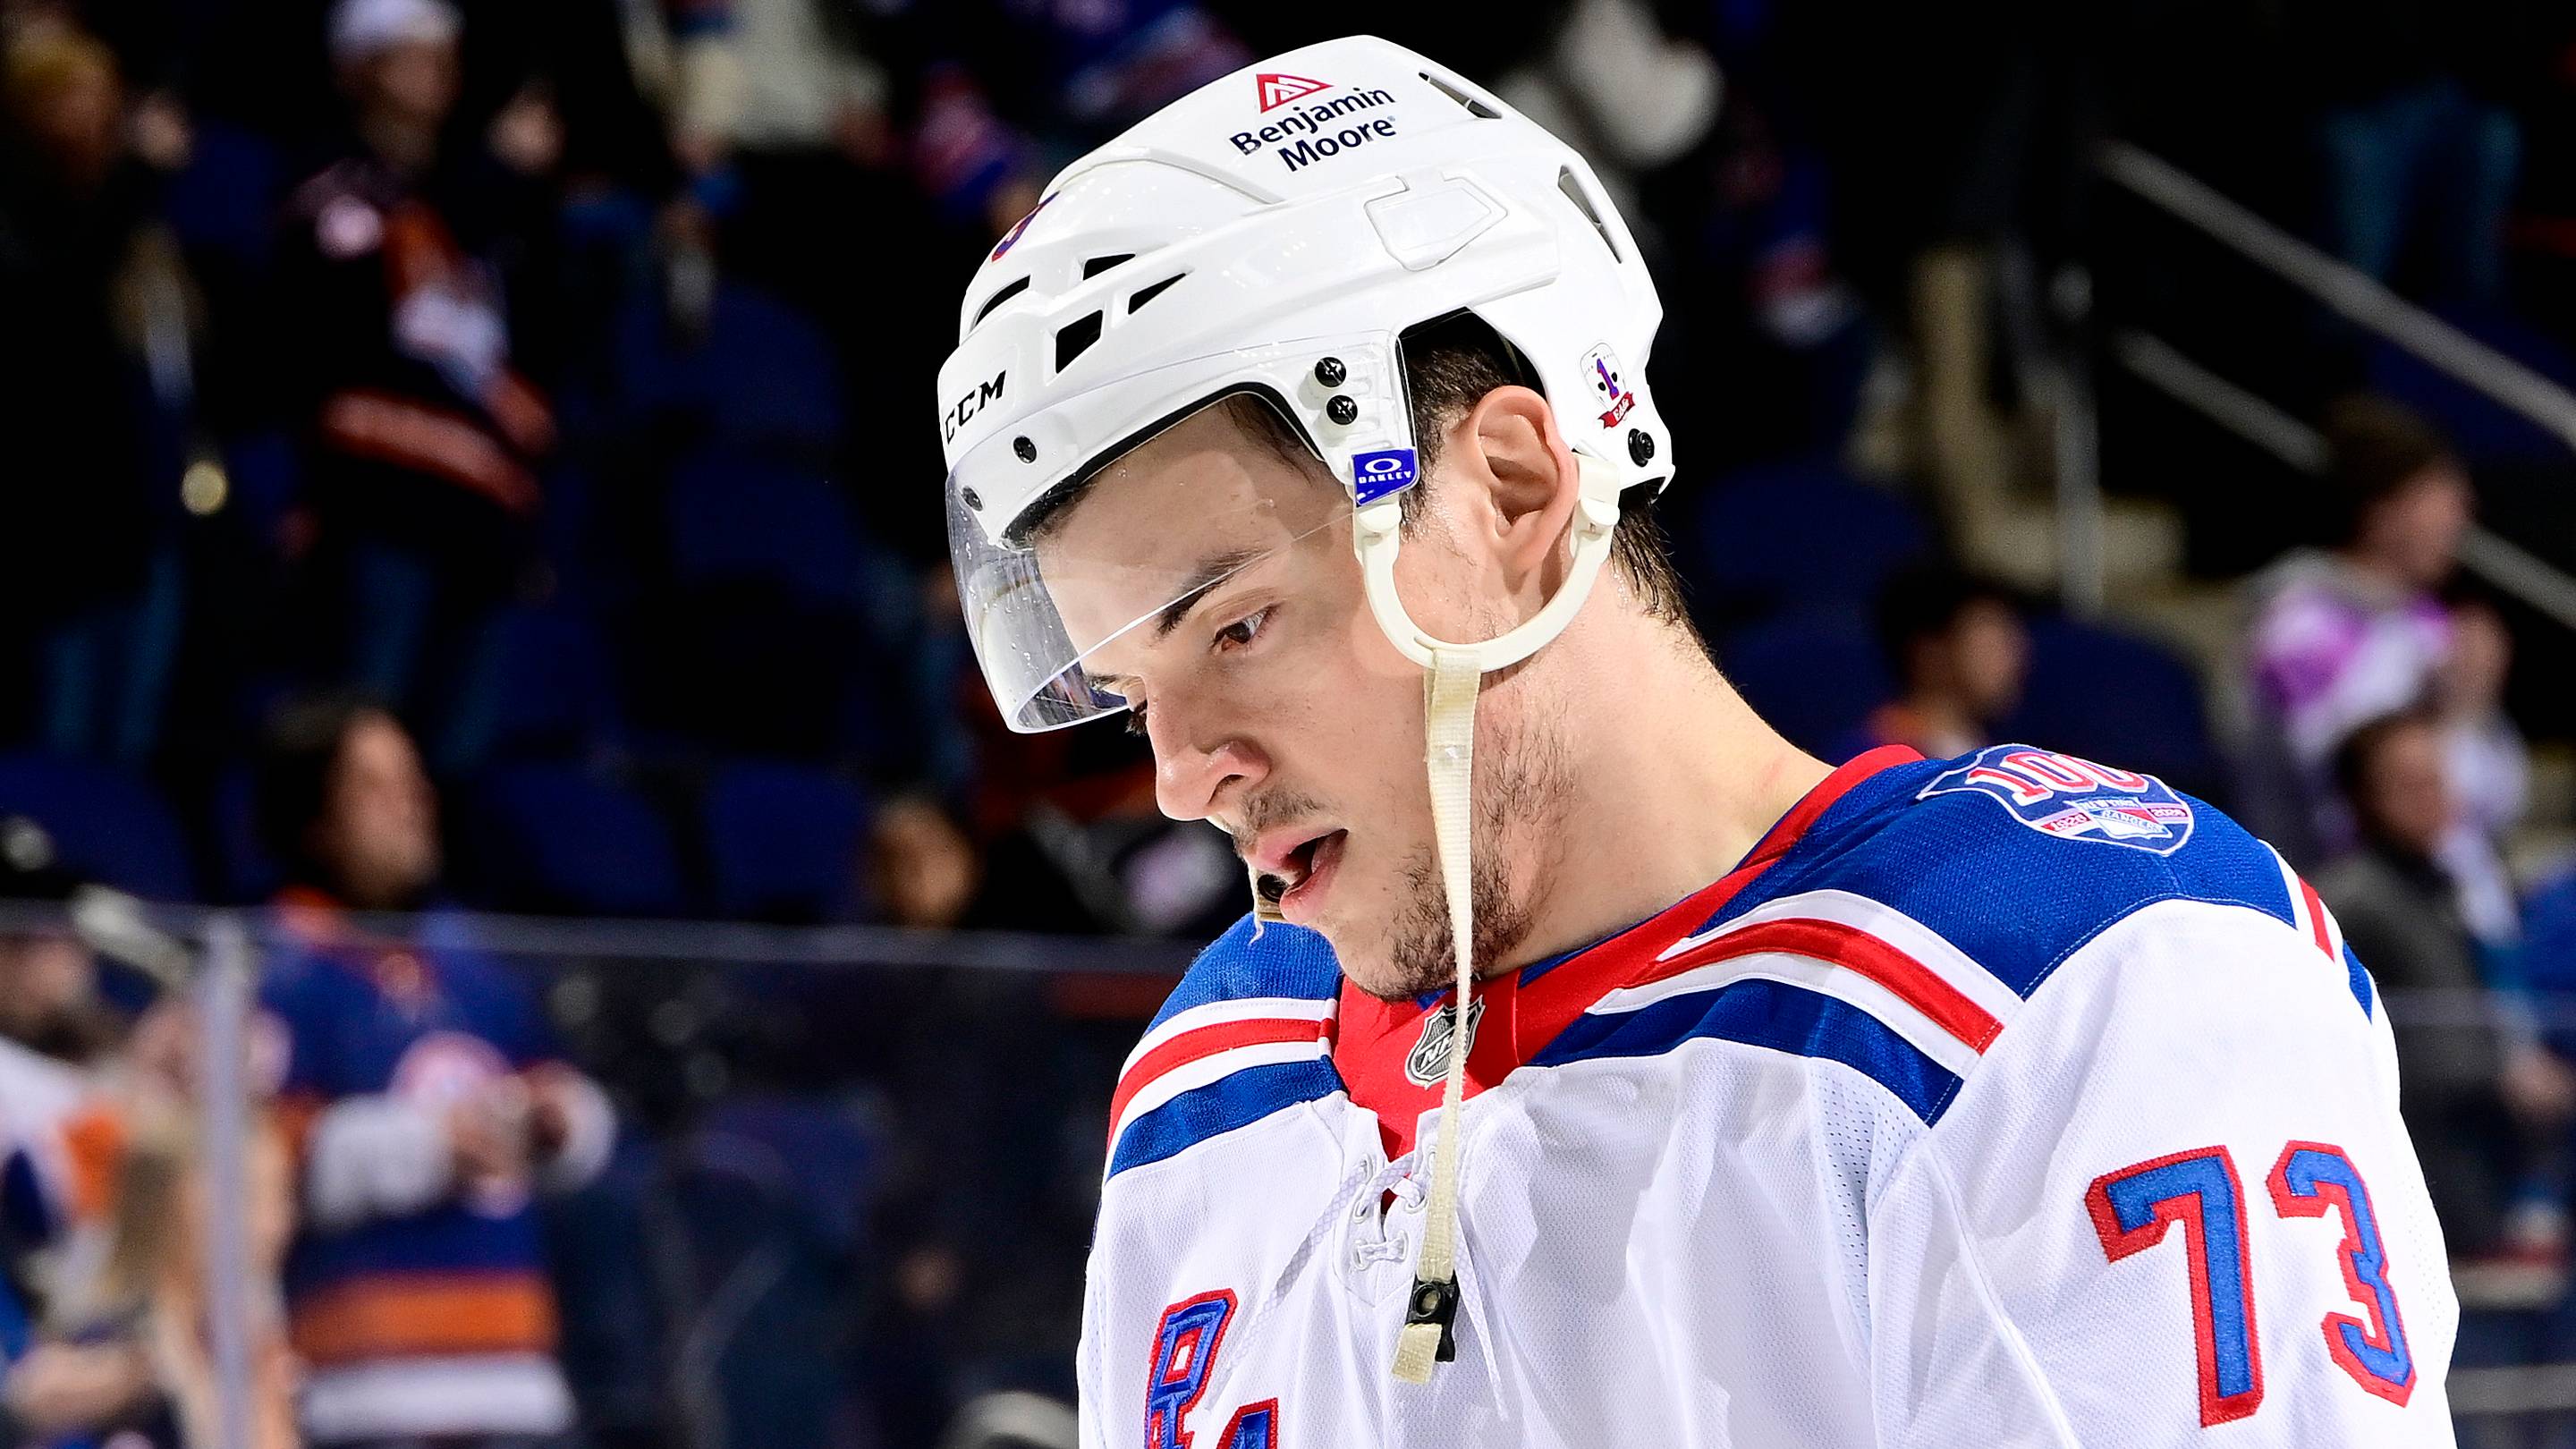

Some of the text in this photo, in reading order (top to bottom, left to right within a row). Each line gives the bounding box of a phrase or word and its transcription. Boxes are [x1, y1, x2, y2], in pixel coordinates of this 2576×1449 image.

[1229, 87, 1396, 156] Benjamin
[945, 369, 1007, 445] CCM
[1358, 470, 1411, 484] OAKLEY
[1964, 750, 2149, 806] 100
[2084, 1139, 2418, 1428] 73
